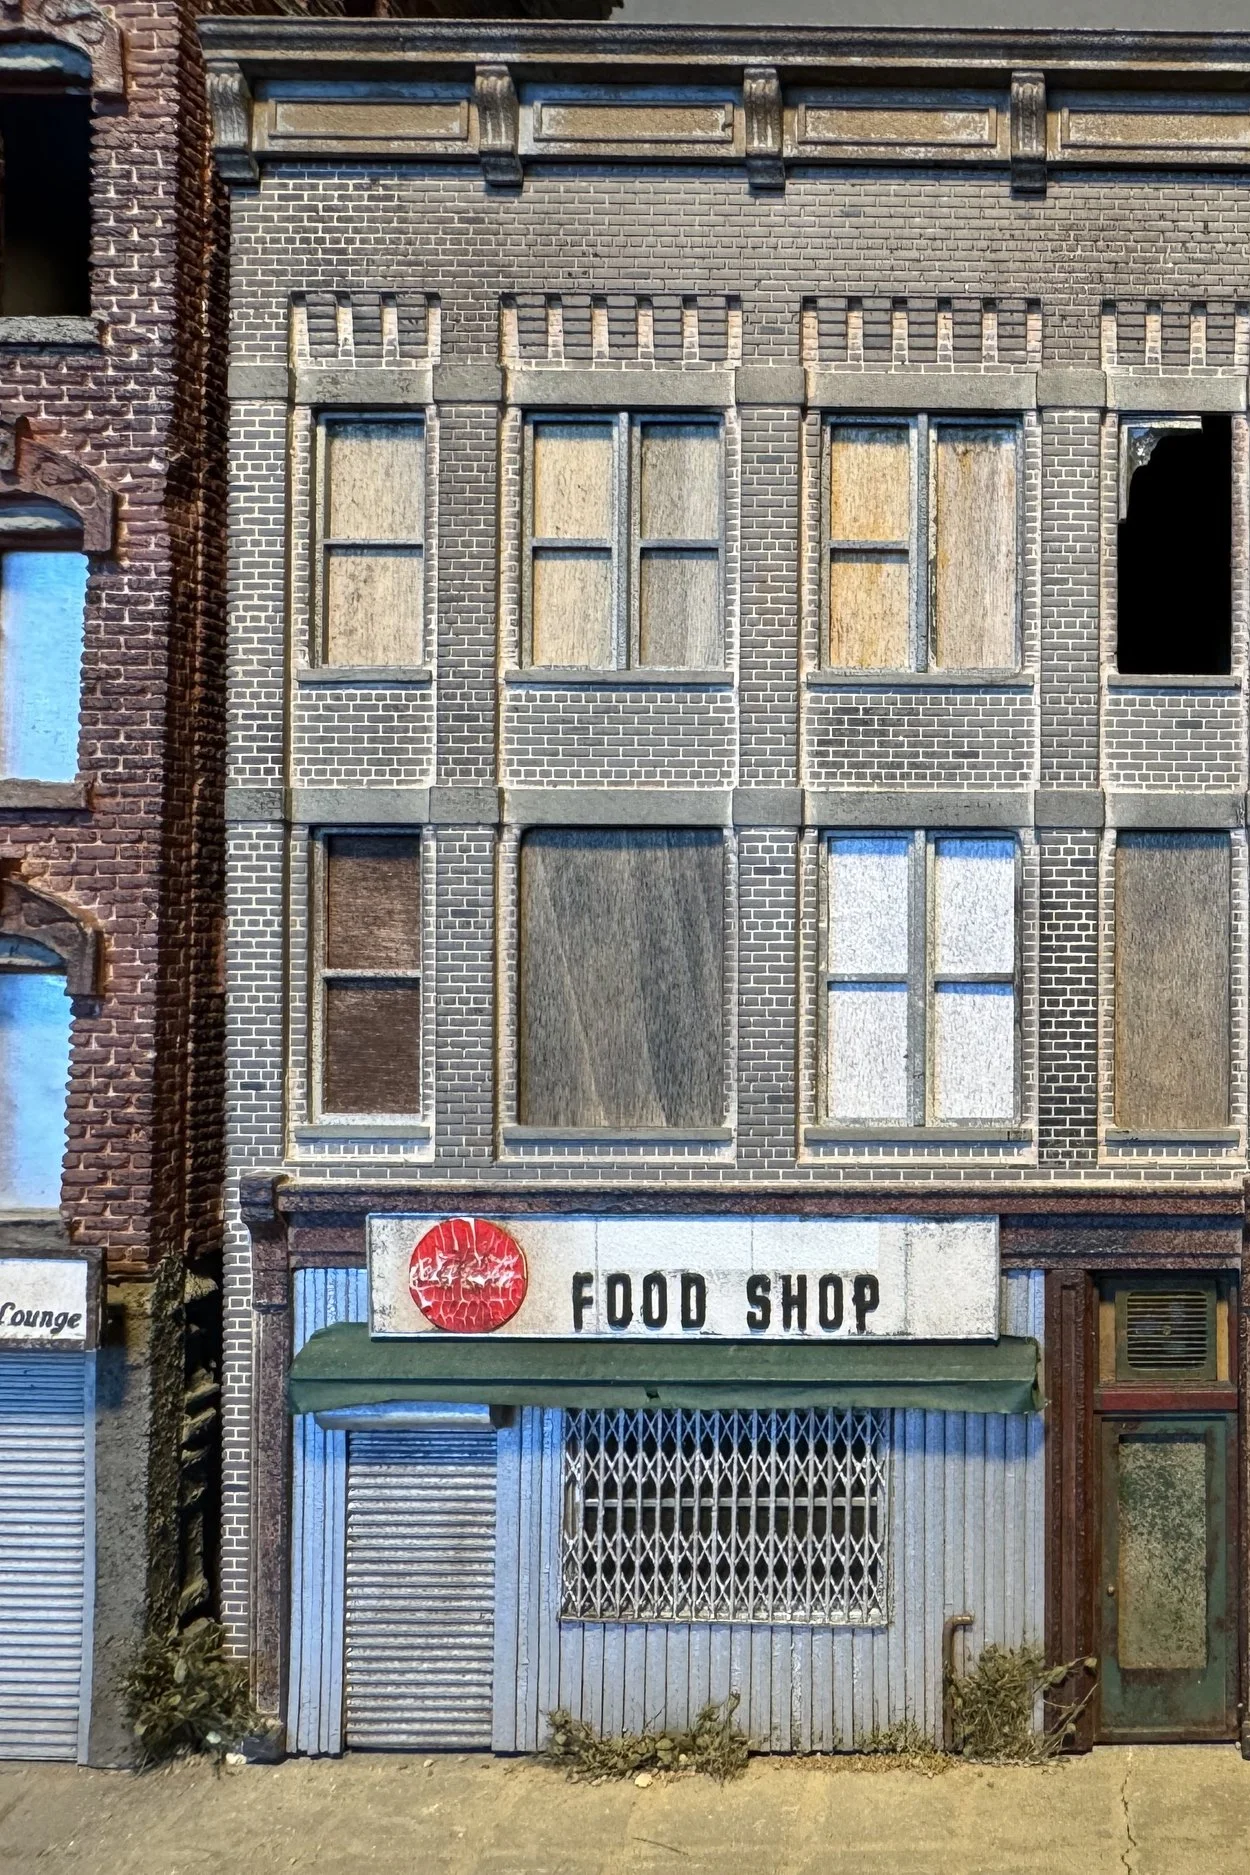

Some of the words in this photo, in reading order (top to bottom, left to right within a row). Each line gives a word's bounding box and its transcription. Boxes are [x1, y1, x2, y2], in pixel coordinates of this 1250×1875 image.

[0, 1301, 82, 1335] Lounge
[571, 1270, 708, 1331] FOOD
[745, 1271, 881, 1334] SHOP
